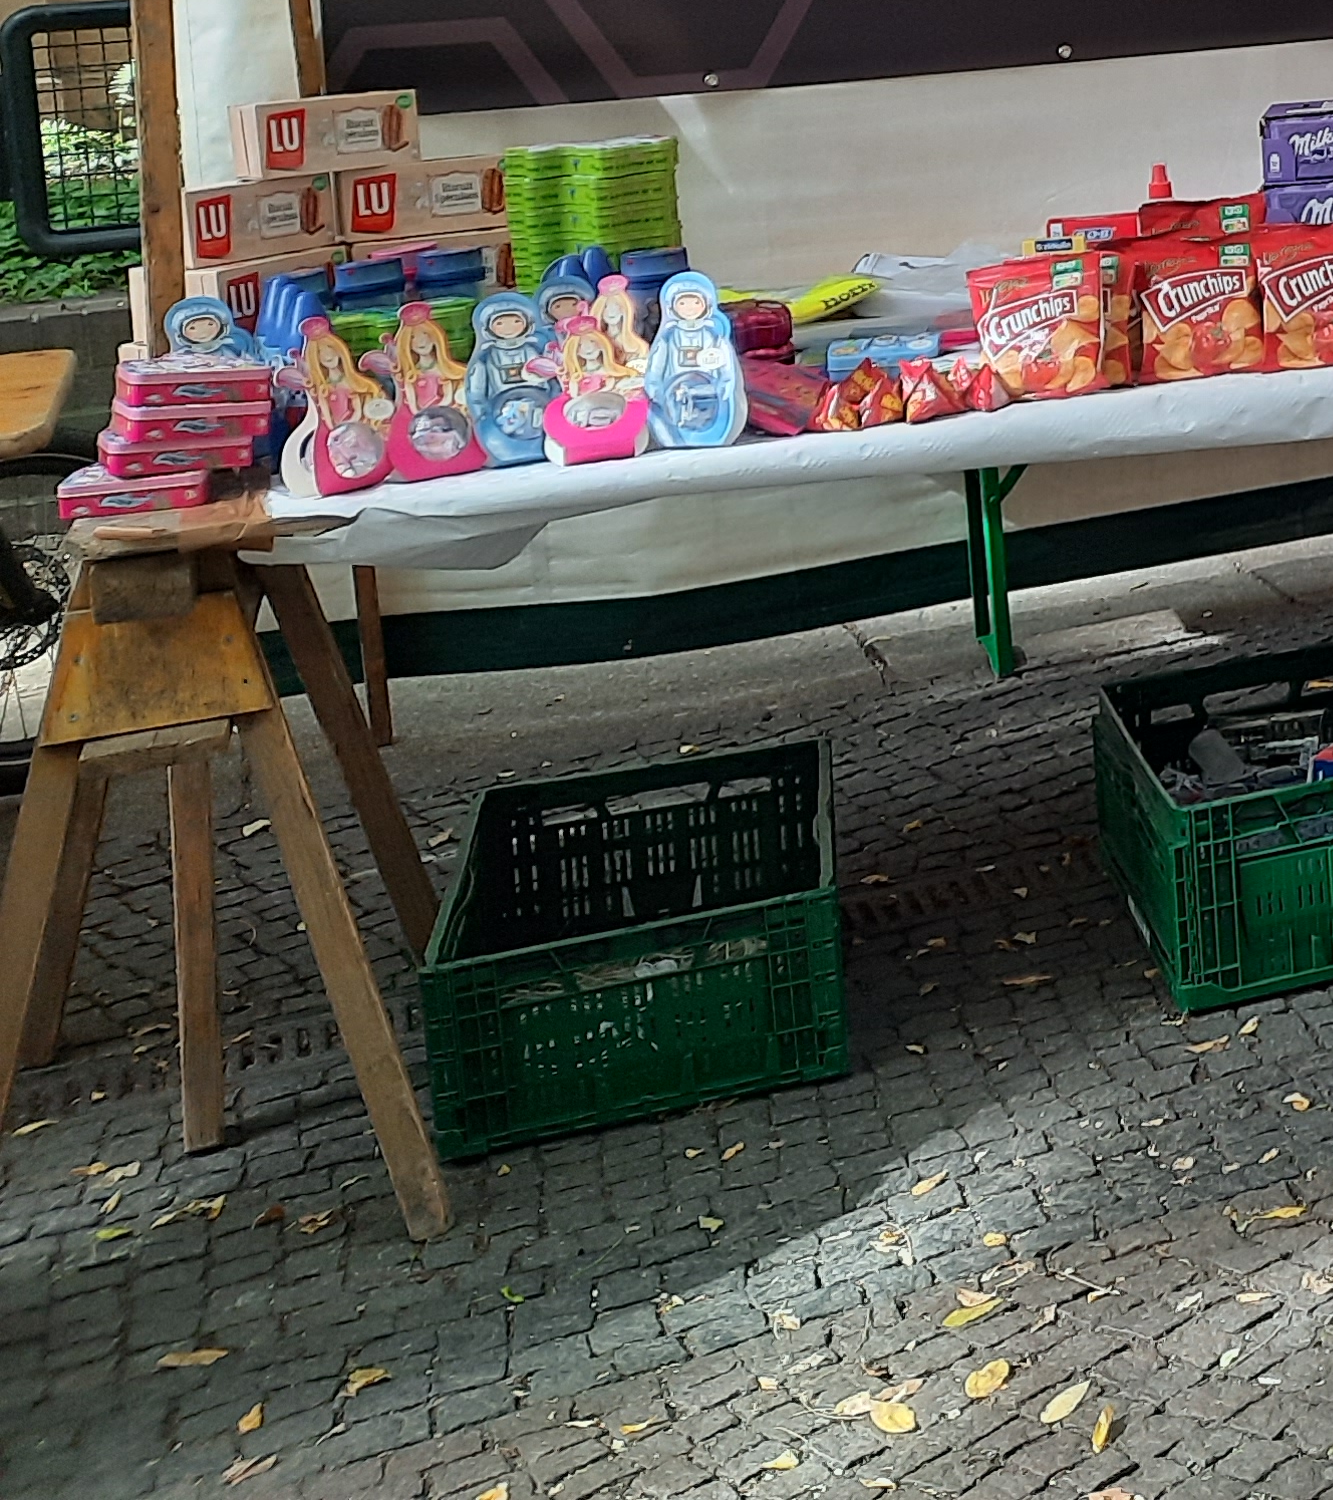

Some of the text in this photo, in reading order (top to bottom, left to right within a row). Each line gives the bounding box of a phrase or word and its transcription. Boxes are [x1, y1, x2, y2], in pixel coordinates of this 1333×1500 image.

[269, 116, 300, 153] LU
[356, 181, 390, 217] LU
[199, 203, 227, 241] LU
[230, 280, 256, 319] LU
[1157, 271, 1241, 318] Crunchips
[988, 295, 1072, 345] Crunchips
